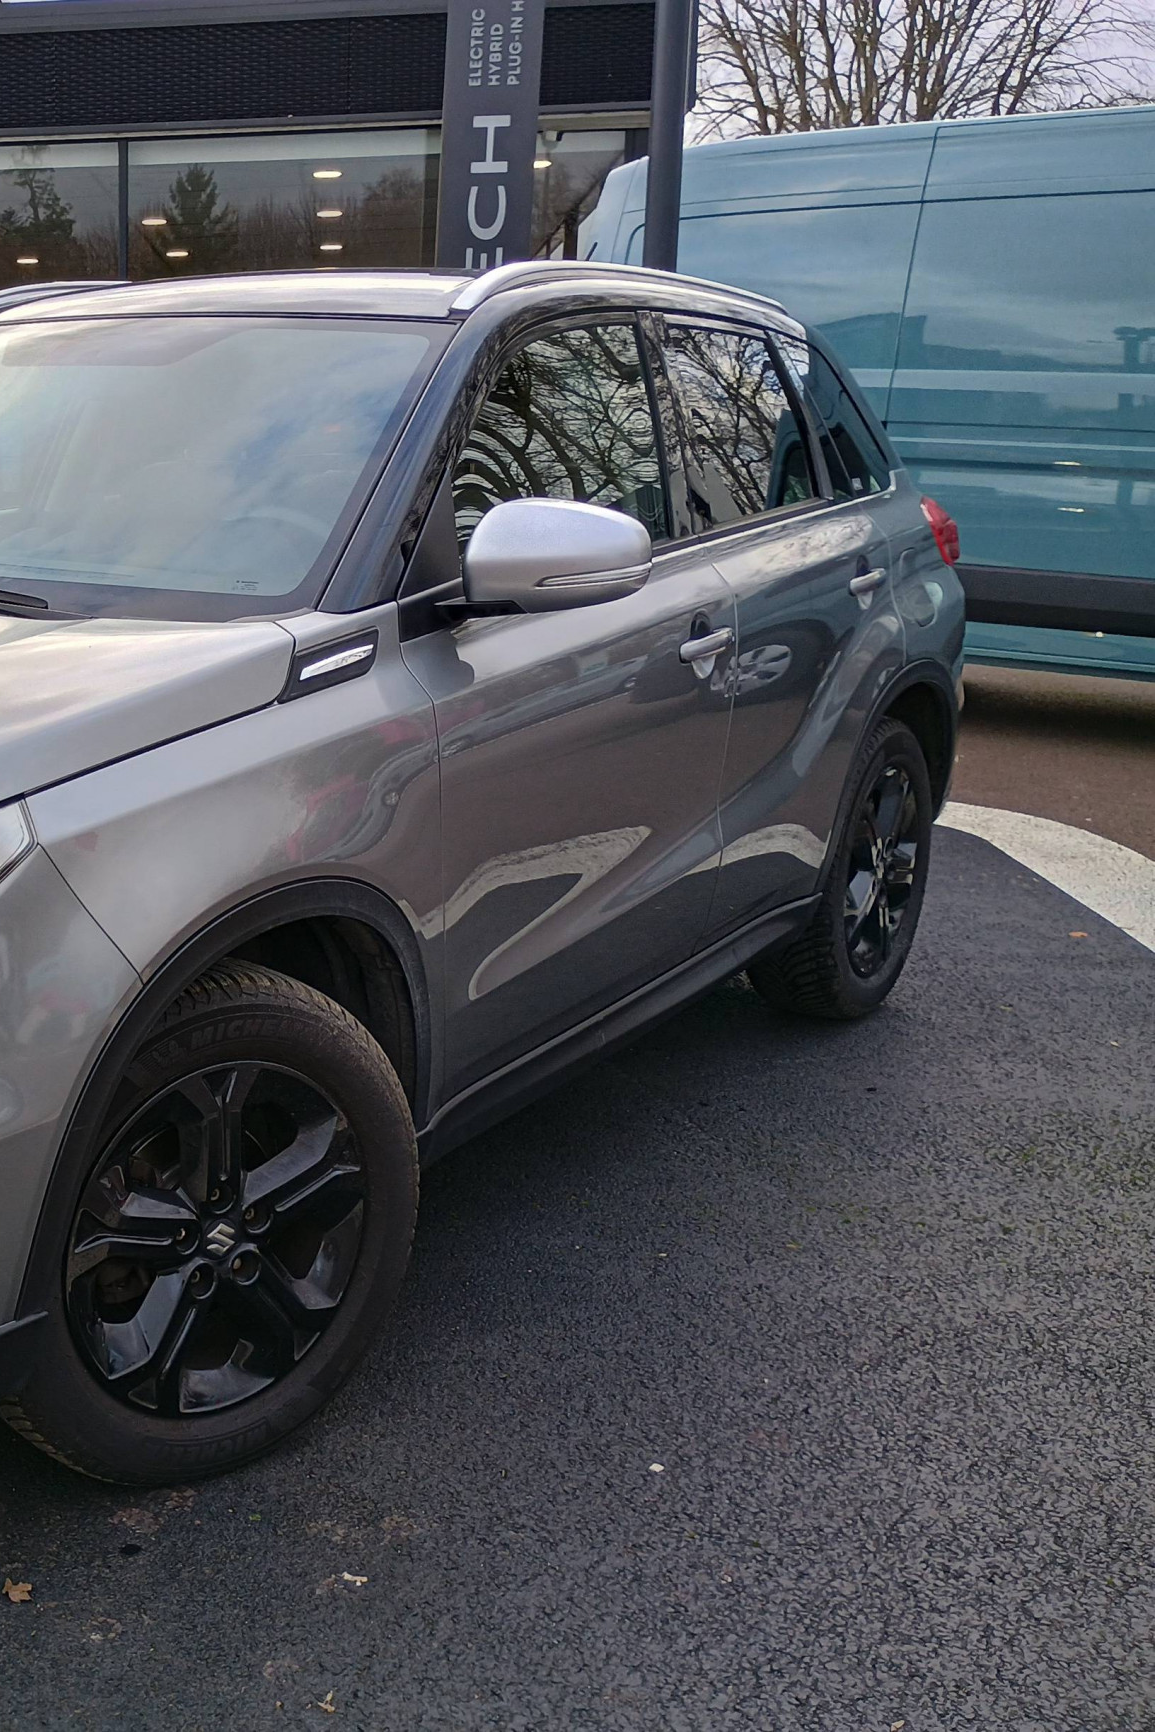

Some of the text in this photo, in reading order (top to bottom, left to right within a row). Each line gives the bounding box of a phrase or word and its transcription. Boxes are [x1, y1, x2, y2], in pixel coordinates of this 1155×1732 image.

[468, 8, 486, 87] ELECTRIC
[487, 23, 504, 86] HYBRID
[506, 16, 524, 86] PLUG-IN
